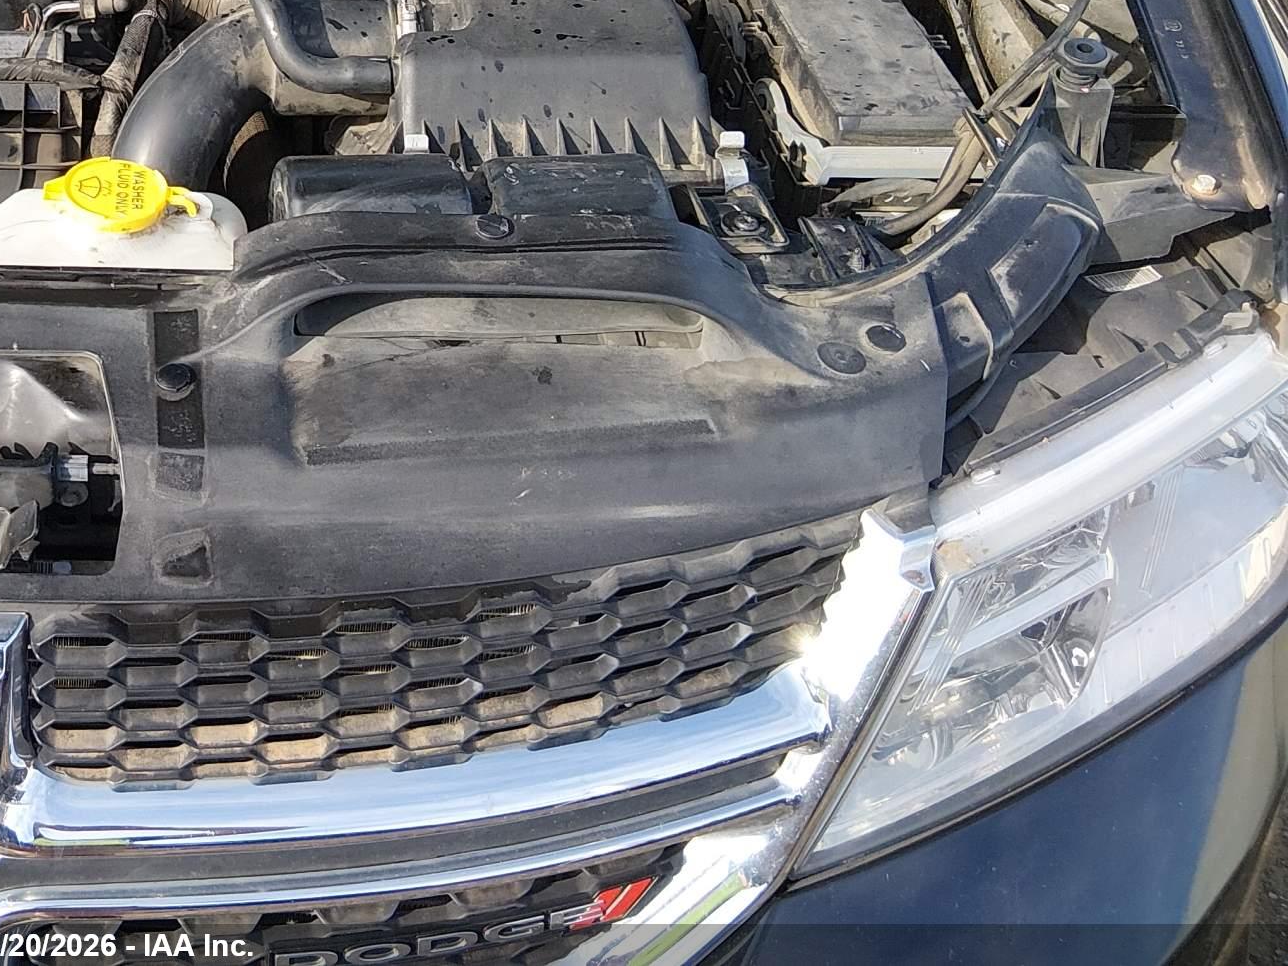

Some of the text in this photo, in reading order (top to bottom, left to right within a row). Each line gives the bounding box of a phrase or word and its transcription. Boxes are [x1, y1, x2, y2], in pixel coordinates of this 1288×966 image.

[115, 163, 130, 215] FLUID ONLY
[132, 170, 146, 210] WASHER
[272, 900, 605, 966] DODGE
